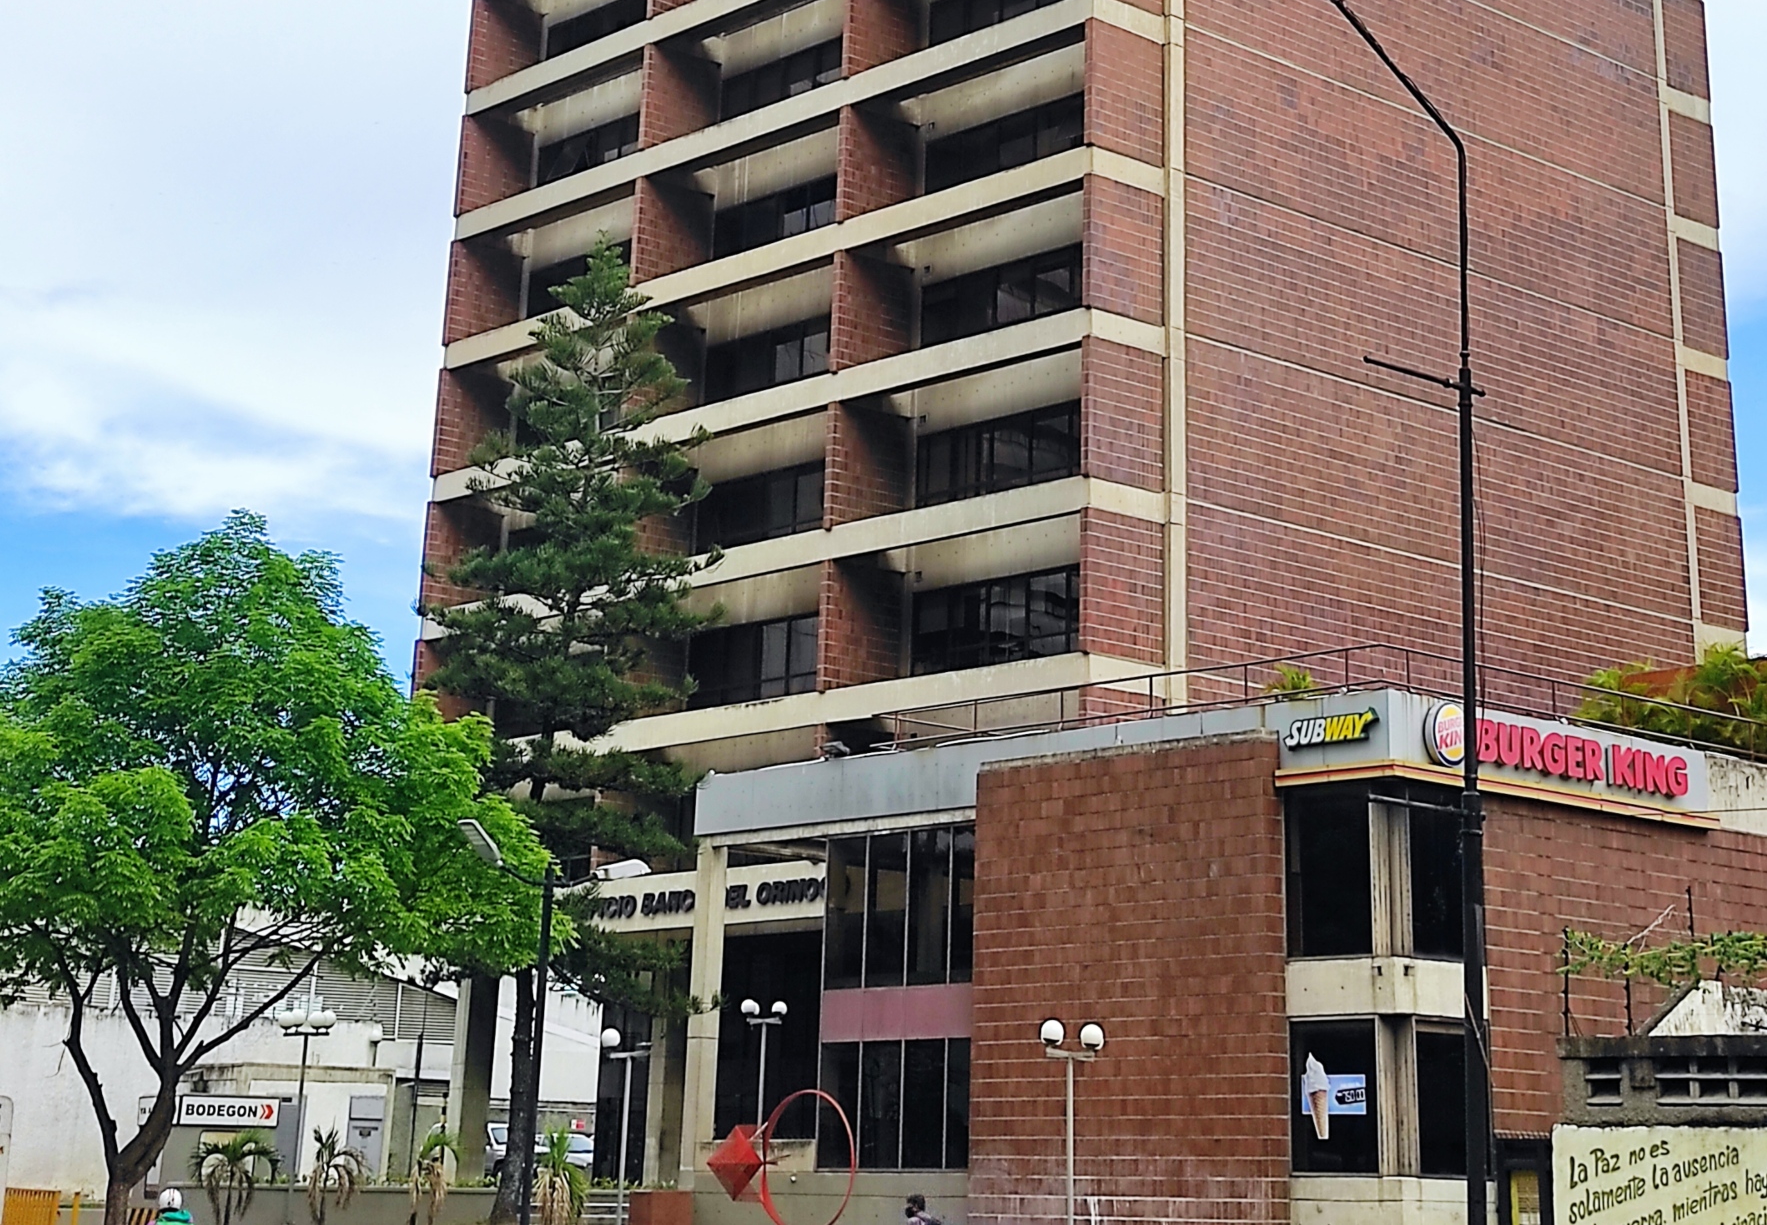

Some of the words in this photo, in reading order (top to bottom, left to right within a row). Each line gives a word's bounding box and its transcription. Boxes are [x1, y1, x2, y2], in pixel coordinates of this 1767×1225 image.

[1284, 708, 1375, 750] SUBWAY
[1437, 729, 1462, 750] KIN
[1475, 718, 1605, 781] BURGER
[1611, 743, 1689, 796] KING
[640, 888, 696, 916] BANC
[185, 1103, 258, 1118] BODEGON
[1568, 1175, 1646, 1225] solamente
[1671, 1145, 1740, 1183] ausencia
[1569, 1156, 1588, 1189] La
[1590, 1148, 1621, 1177] Paz
[1628, 1146, 1646, 1166] no
[1649, 1140, 1670, 1159] es
[1672, 1180, 1738, 1223] mientras
